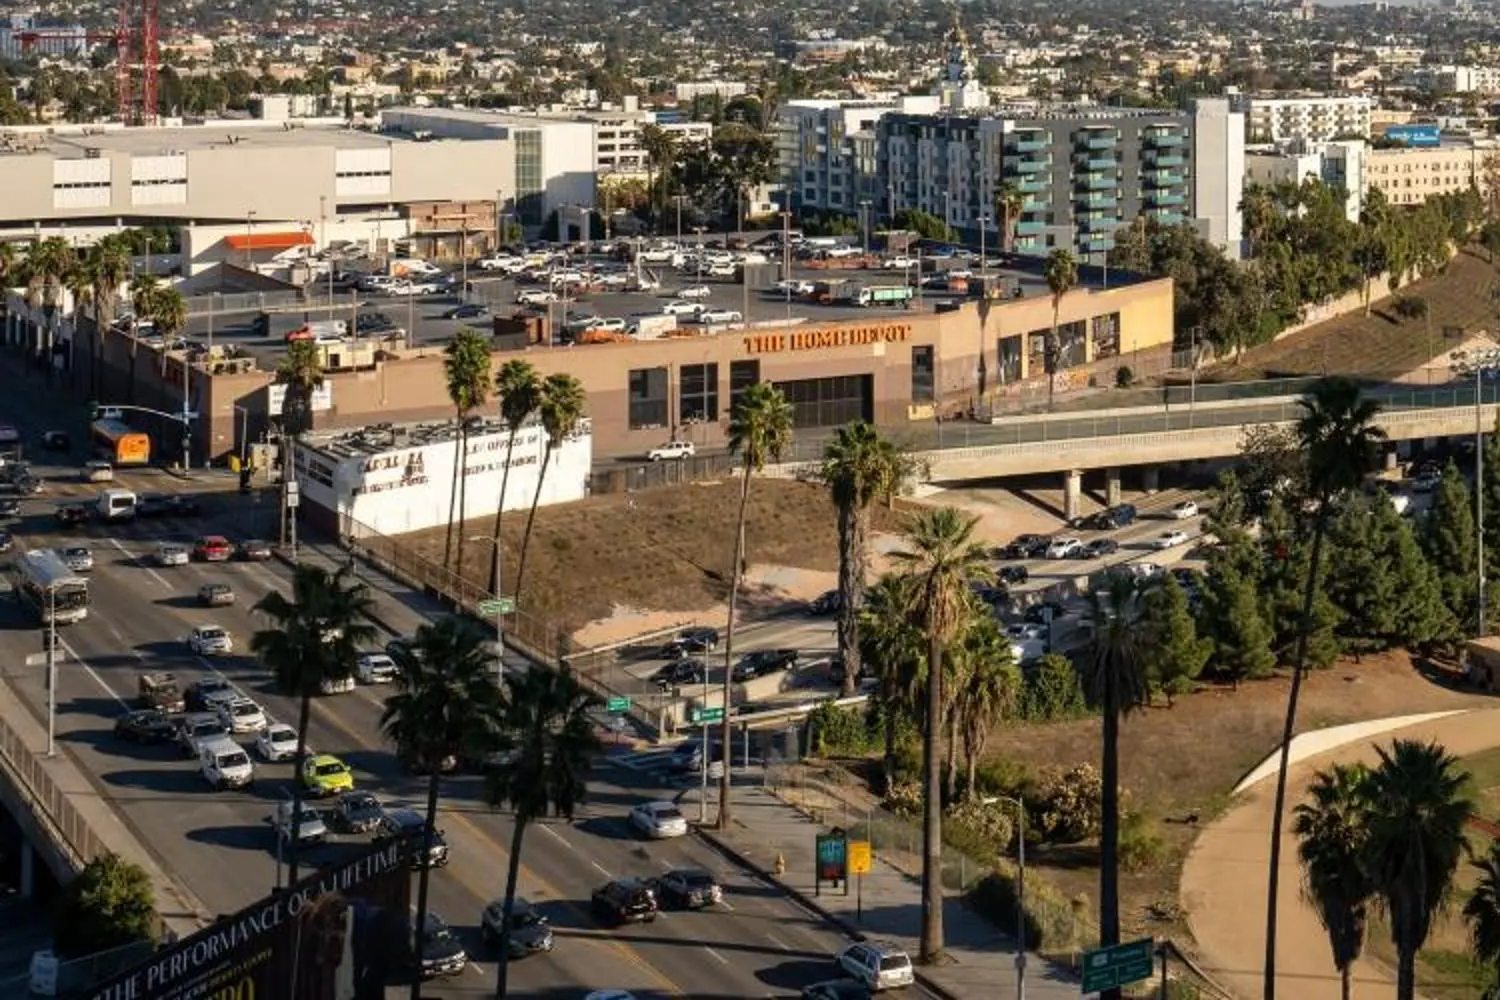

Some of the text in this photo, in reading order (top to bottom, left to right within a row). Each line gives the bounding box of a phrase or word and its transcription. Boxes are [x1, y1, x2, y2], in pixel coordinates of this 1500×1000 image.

[744, 322, 912, 354] THE HOME DEPOT
[147, 900, 283, 992] PERFORMANCE
[288, 888, 312, 917] OF
